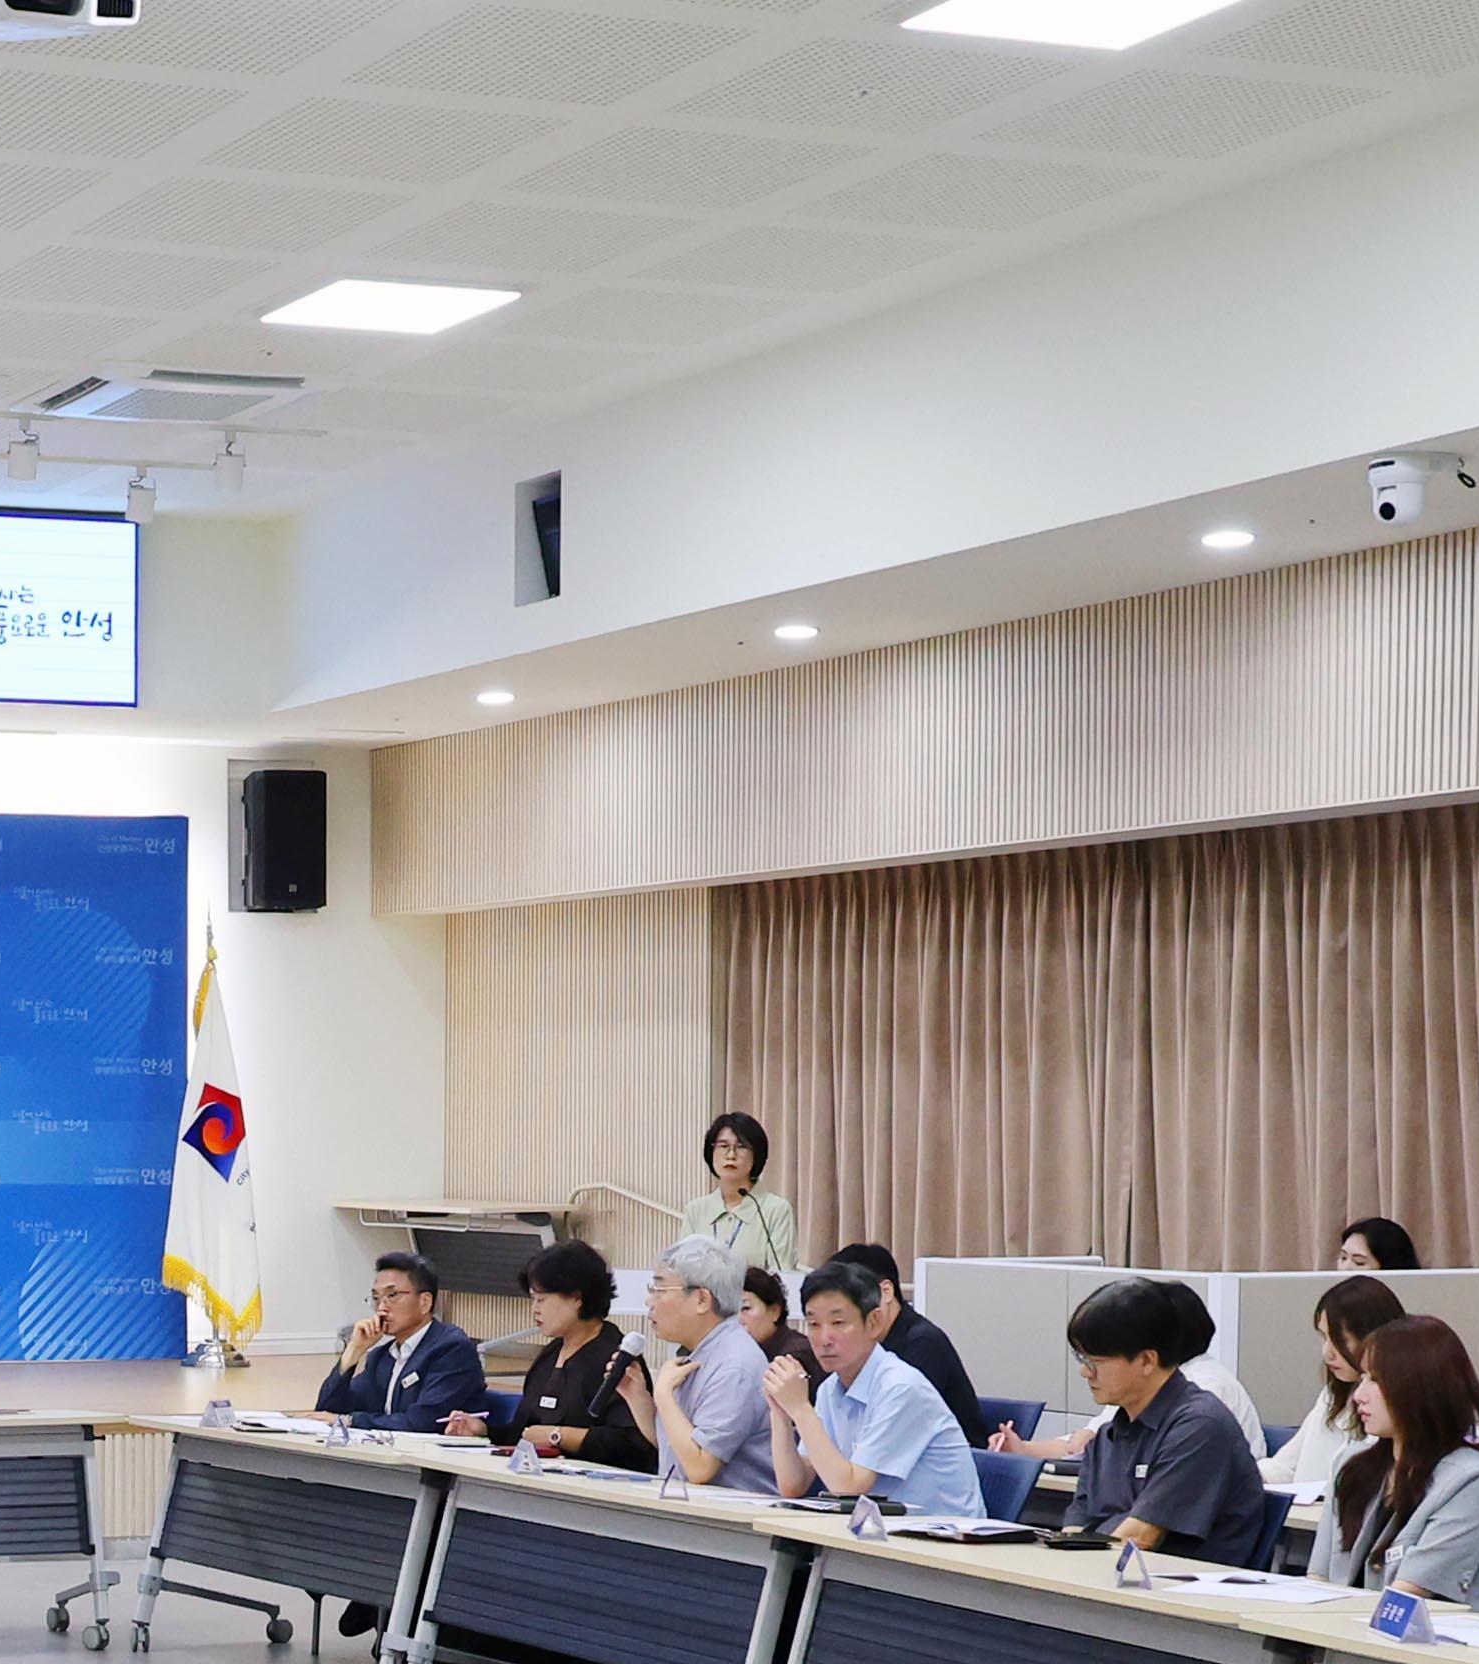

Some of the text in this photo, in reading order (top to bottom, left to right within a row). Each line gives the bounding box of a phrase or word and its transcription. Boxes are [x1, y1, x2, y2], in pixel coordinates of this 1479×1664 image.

[61, 610, 114, 642] 안성
[143, 836, 175, 855] 안성
[141, 947, 173, 965] 안성
[140, 1057, 172, 1076] 안성
[140, 1167, 171, 1186] 안성
